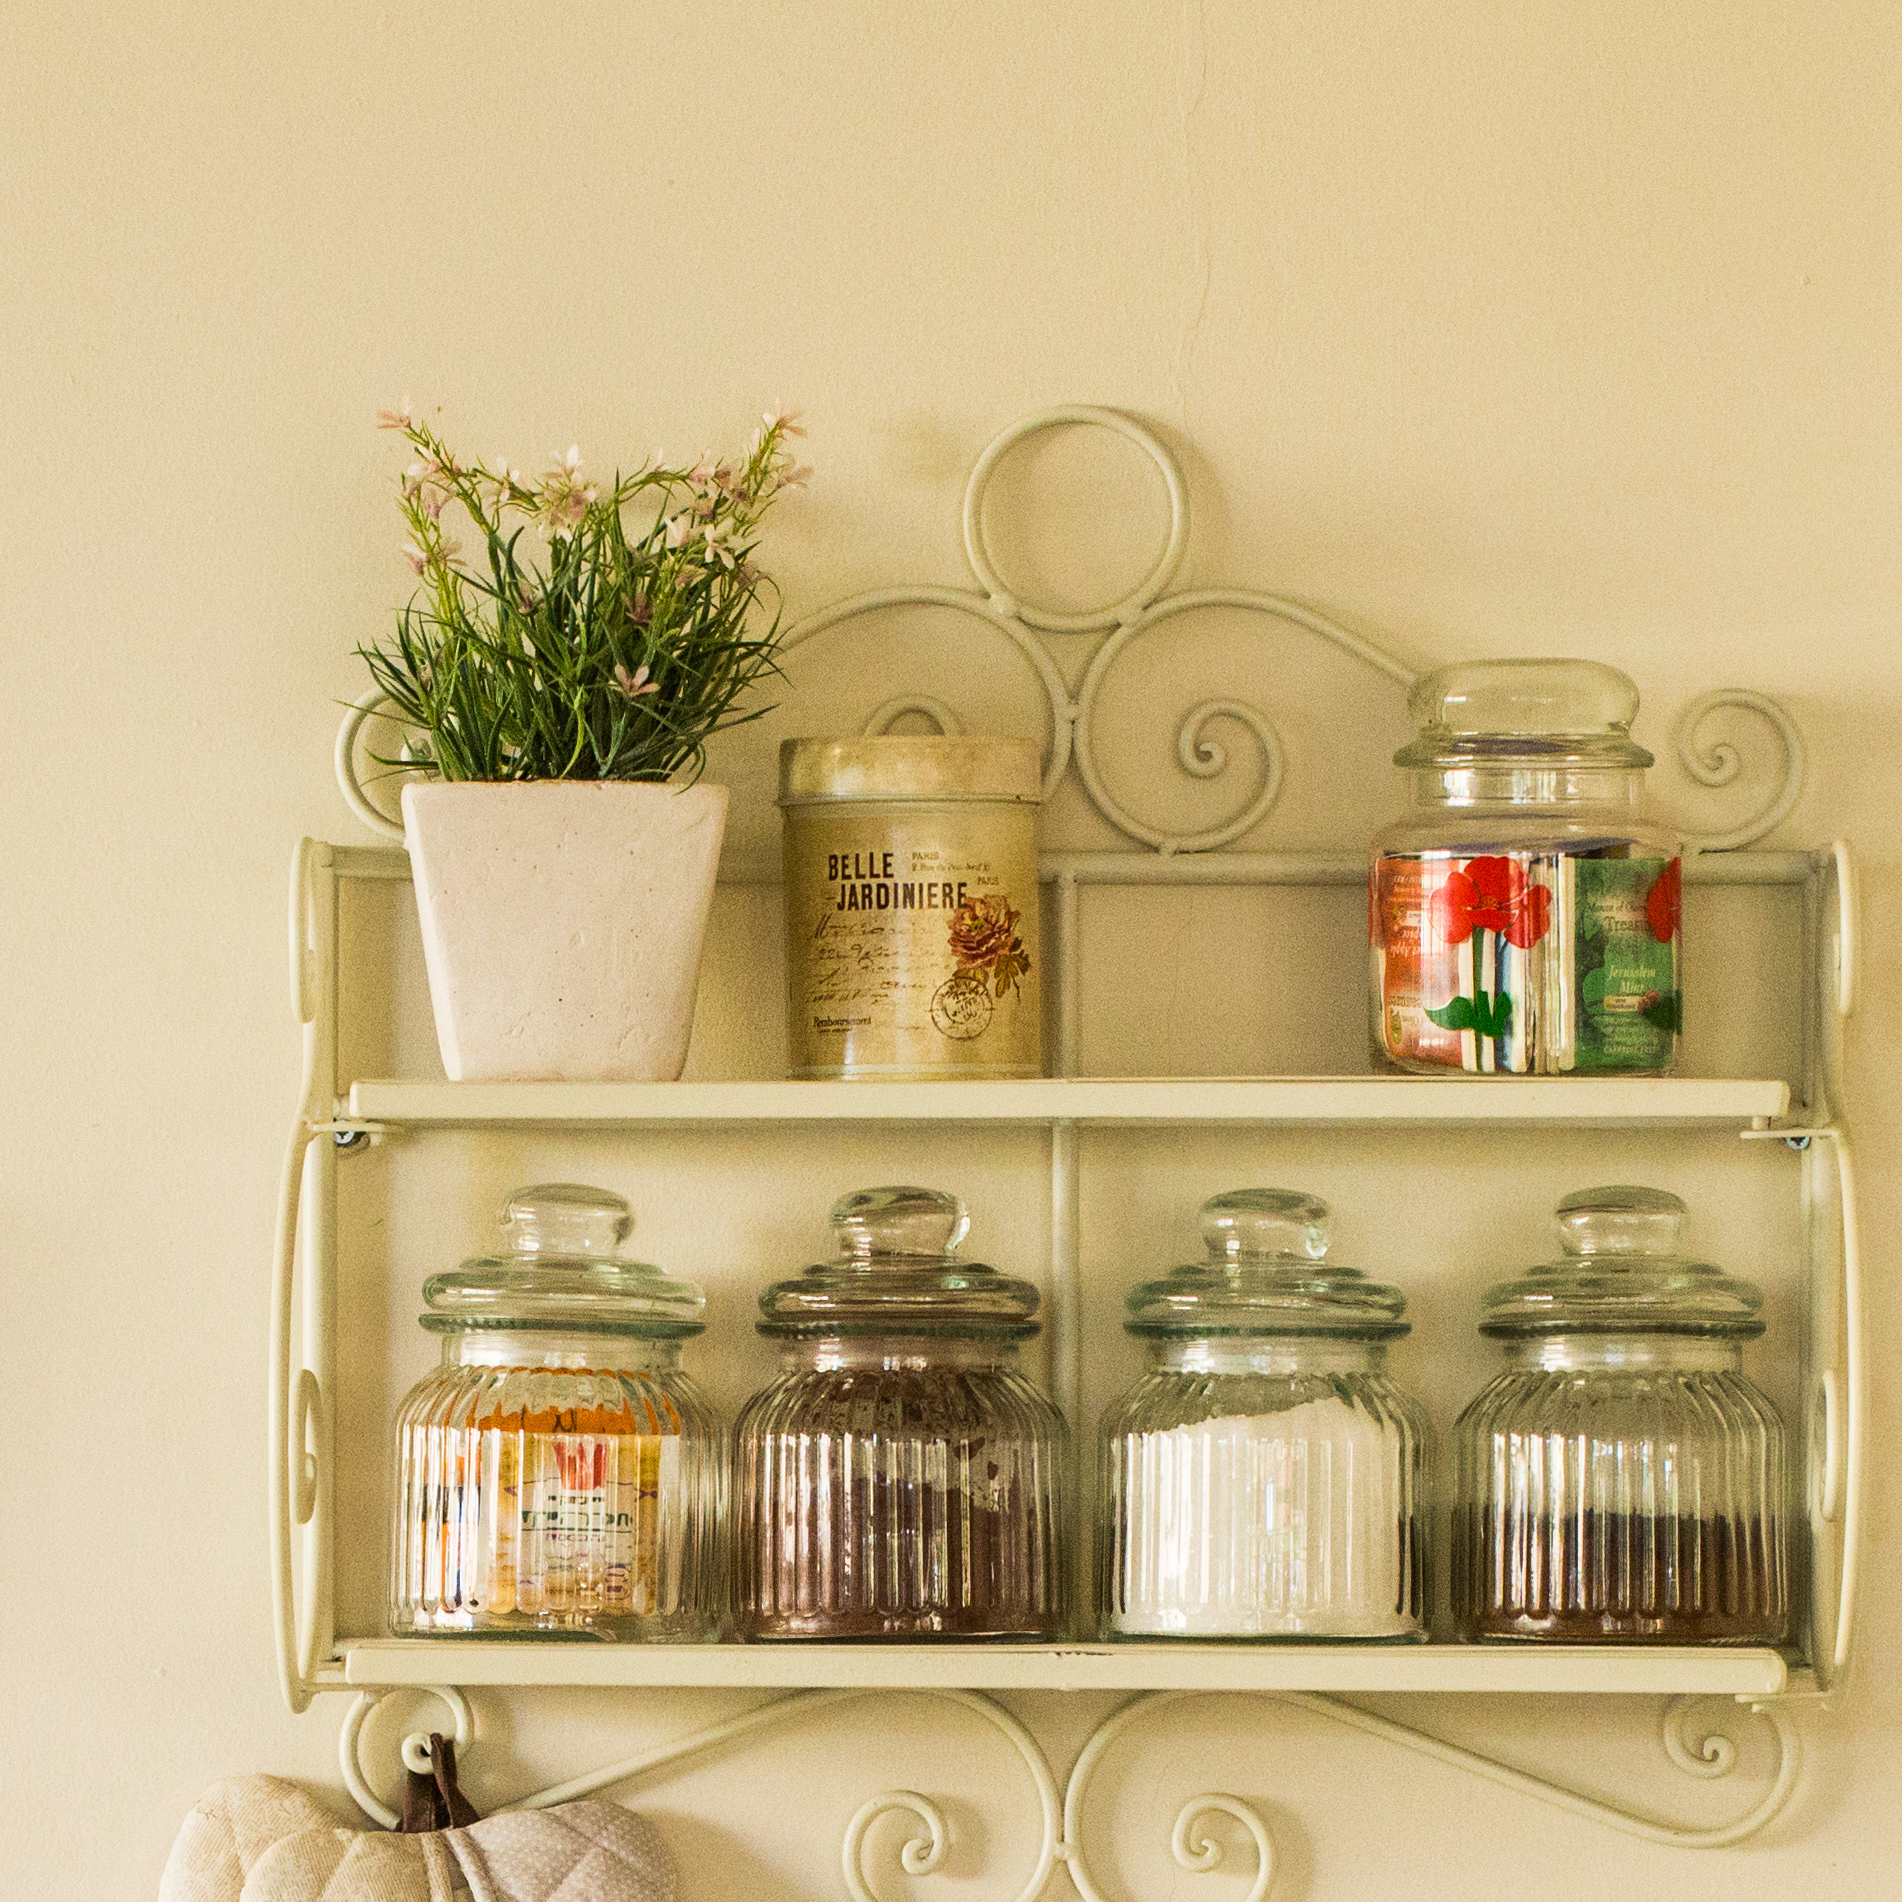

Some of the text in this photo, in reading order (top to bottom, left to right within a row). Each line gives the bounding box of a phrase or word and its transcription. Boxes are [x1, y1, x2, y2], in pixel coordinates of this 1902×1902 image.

[828, 852, 895, 881] BELLE
[911, 852, 940, 861] PARIS
[836, 882, 968, 911] JARDINIERE
